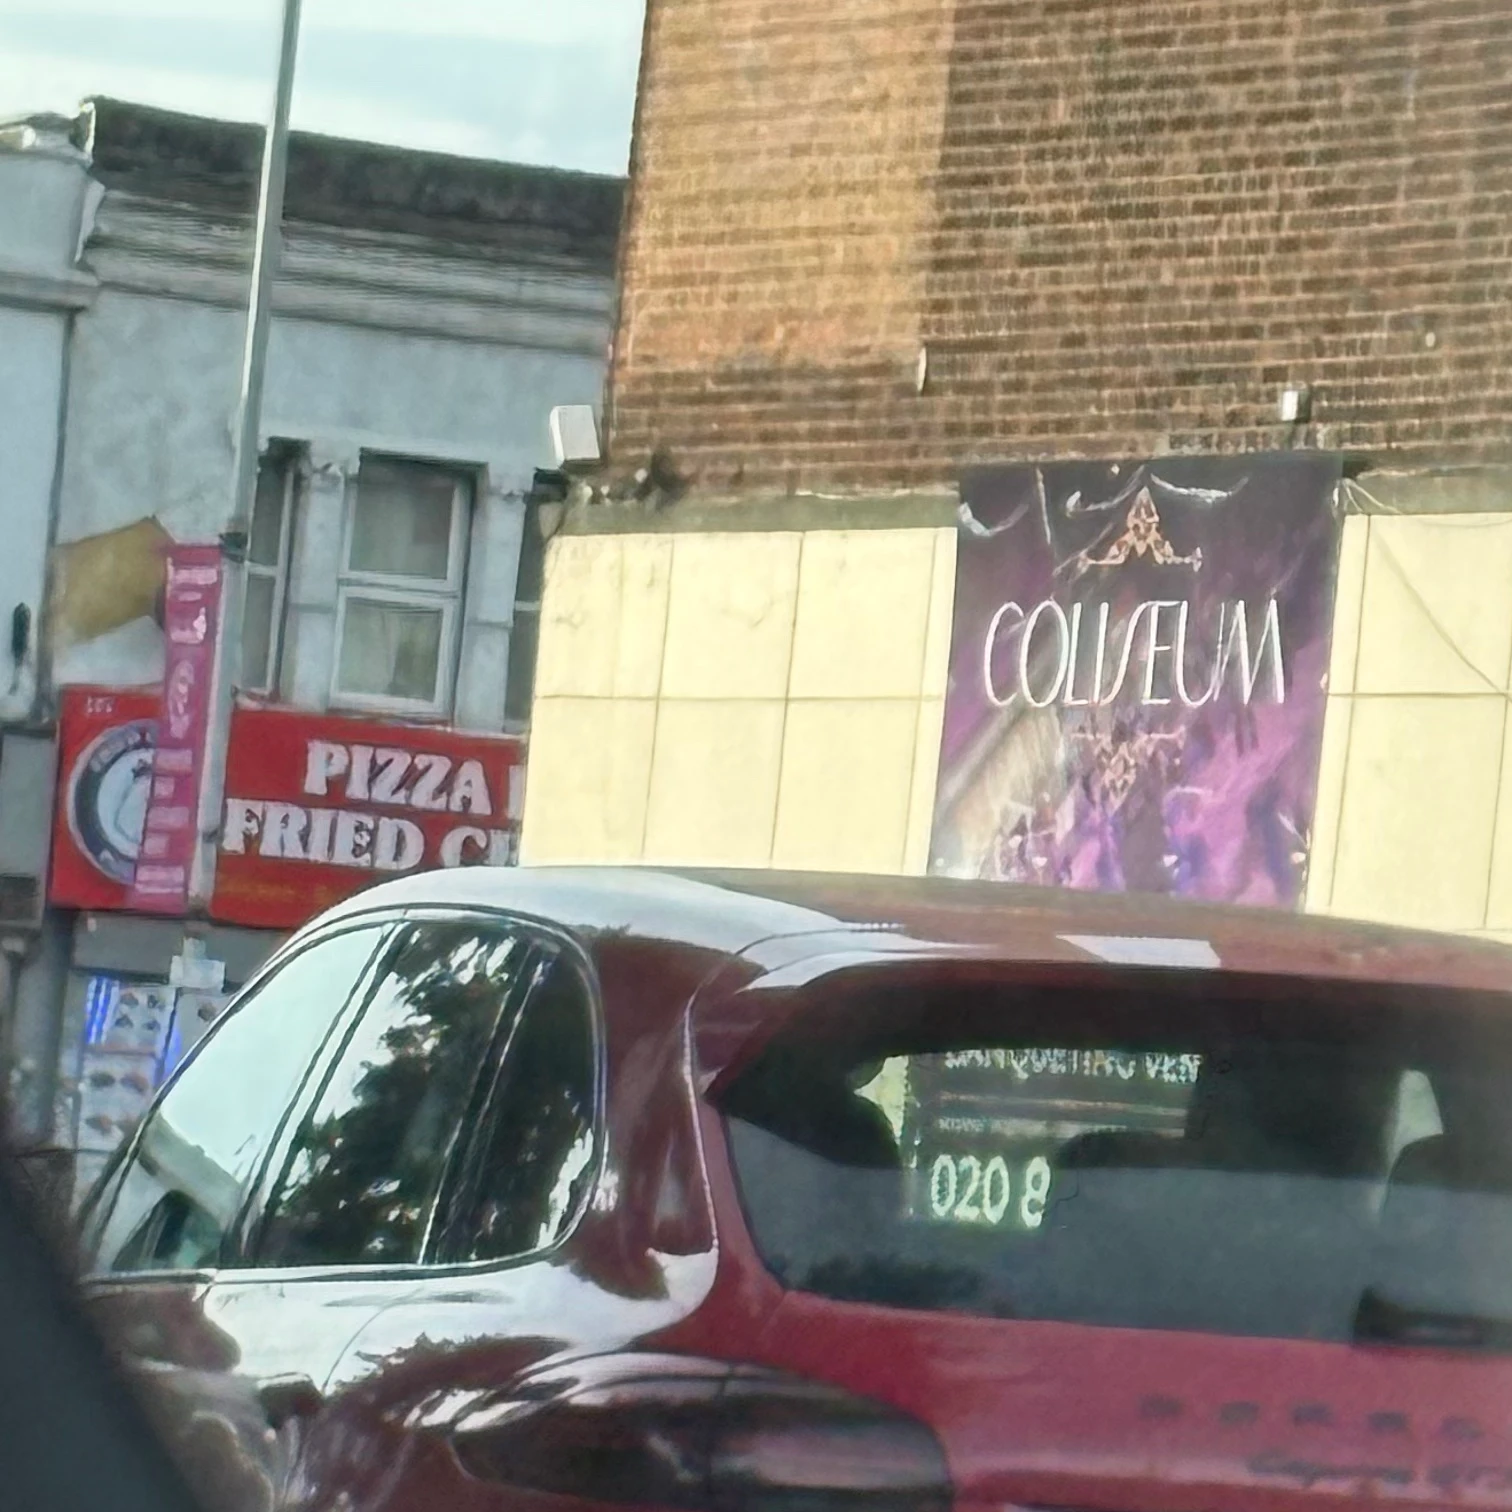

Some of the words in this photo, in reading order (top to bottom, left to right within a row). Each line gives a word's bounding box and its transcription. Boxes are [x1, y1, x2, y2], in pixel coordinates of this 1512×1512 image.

[984, 599, 1285, 708] COLISEUM
[304, 739, 492, 815] PIZZA
[222, 797, 425, 870] FRIED
[931, 1154, 1010, 1223] 020
